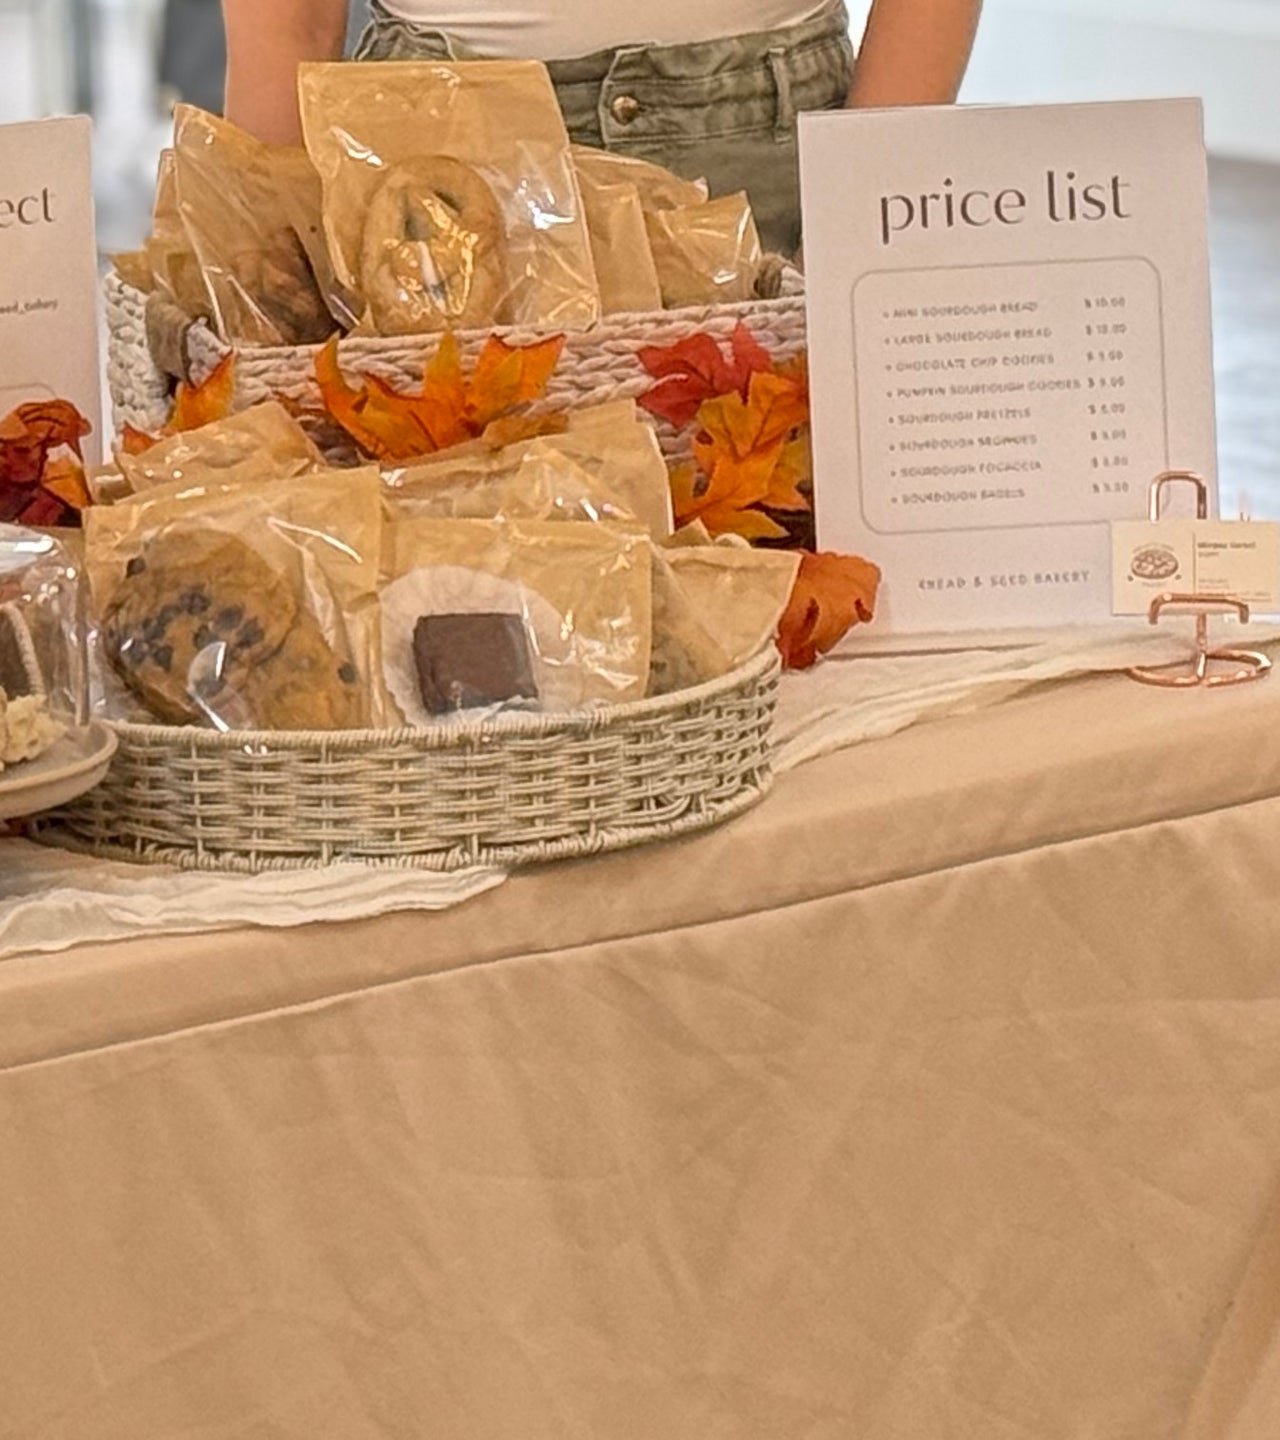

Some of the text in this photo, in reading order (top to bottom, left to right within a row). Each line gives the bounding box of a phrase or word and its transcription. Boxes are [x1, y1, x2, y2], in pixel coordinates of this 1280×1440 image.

[880, 170, 1131, 245] price list
[921, 304, 997, 318] SOURDOUGH
[1000, 302, 1038, 314] BREAD
[894, 334, 931, 346] LARGE
[936, 329, 1011, 343] SOURDOUGH
[1014, 327, 1052, 339] BREAD
[895, 359, 966, 372] CHOCOLATE
[970, 357, 997, 368] CHIP
[1002, 354, 1055, 366] COOKIES
[897, 387, 946, 398] PUMPKIN
[950, 383, 1025, 396] SOURDOUGH
[1027, 379, 1081, 392] COOKIES
[897, 411, 973, 425] SOURDOUGH
[976, 407, 1031, 420] PRETZELS
[899, 438, 974, 451] SOURDOUGH
[900, 464, 976, 477] SOURDOUGH
[979, 461, 1042, 474] FOCACCIA
[902, 491, 977, 504] SOURDOUGH
[990, 574, 1028, 587] SEED
[1034, 571, 1090, 583] BAKERY
